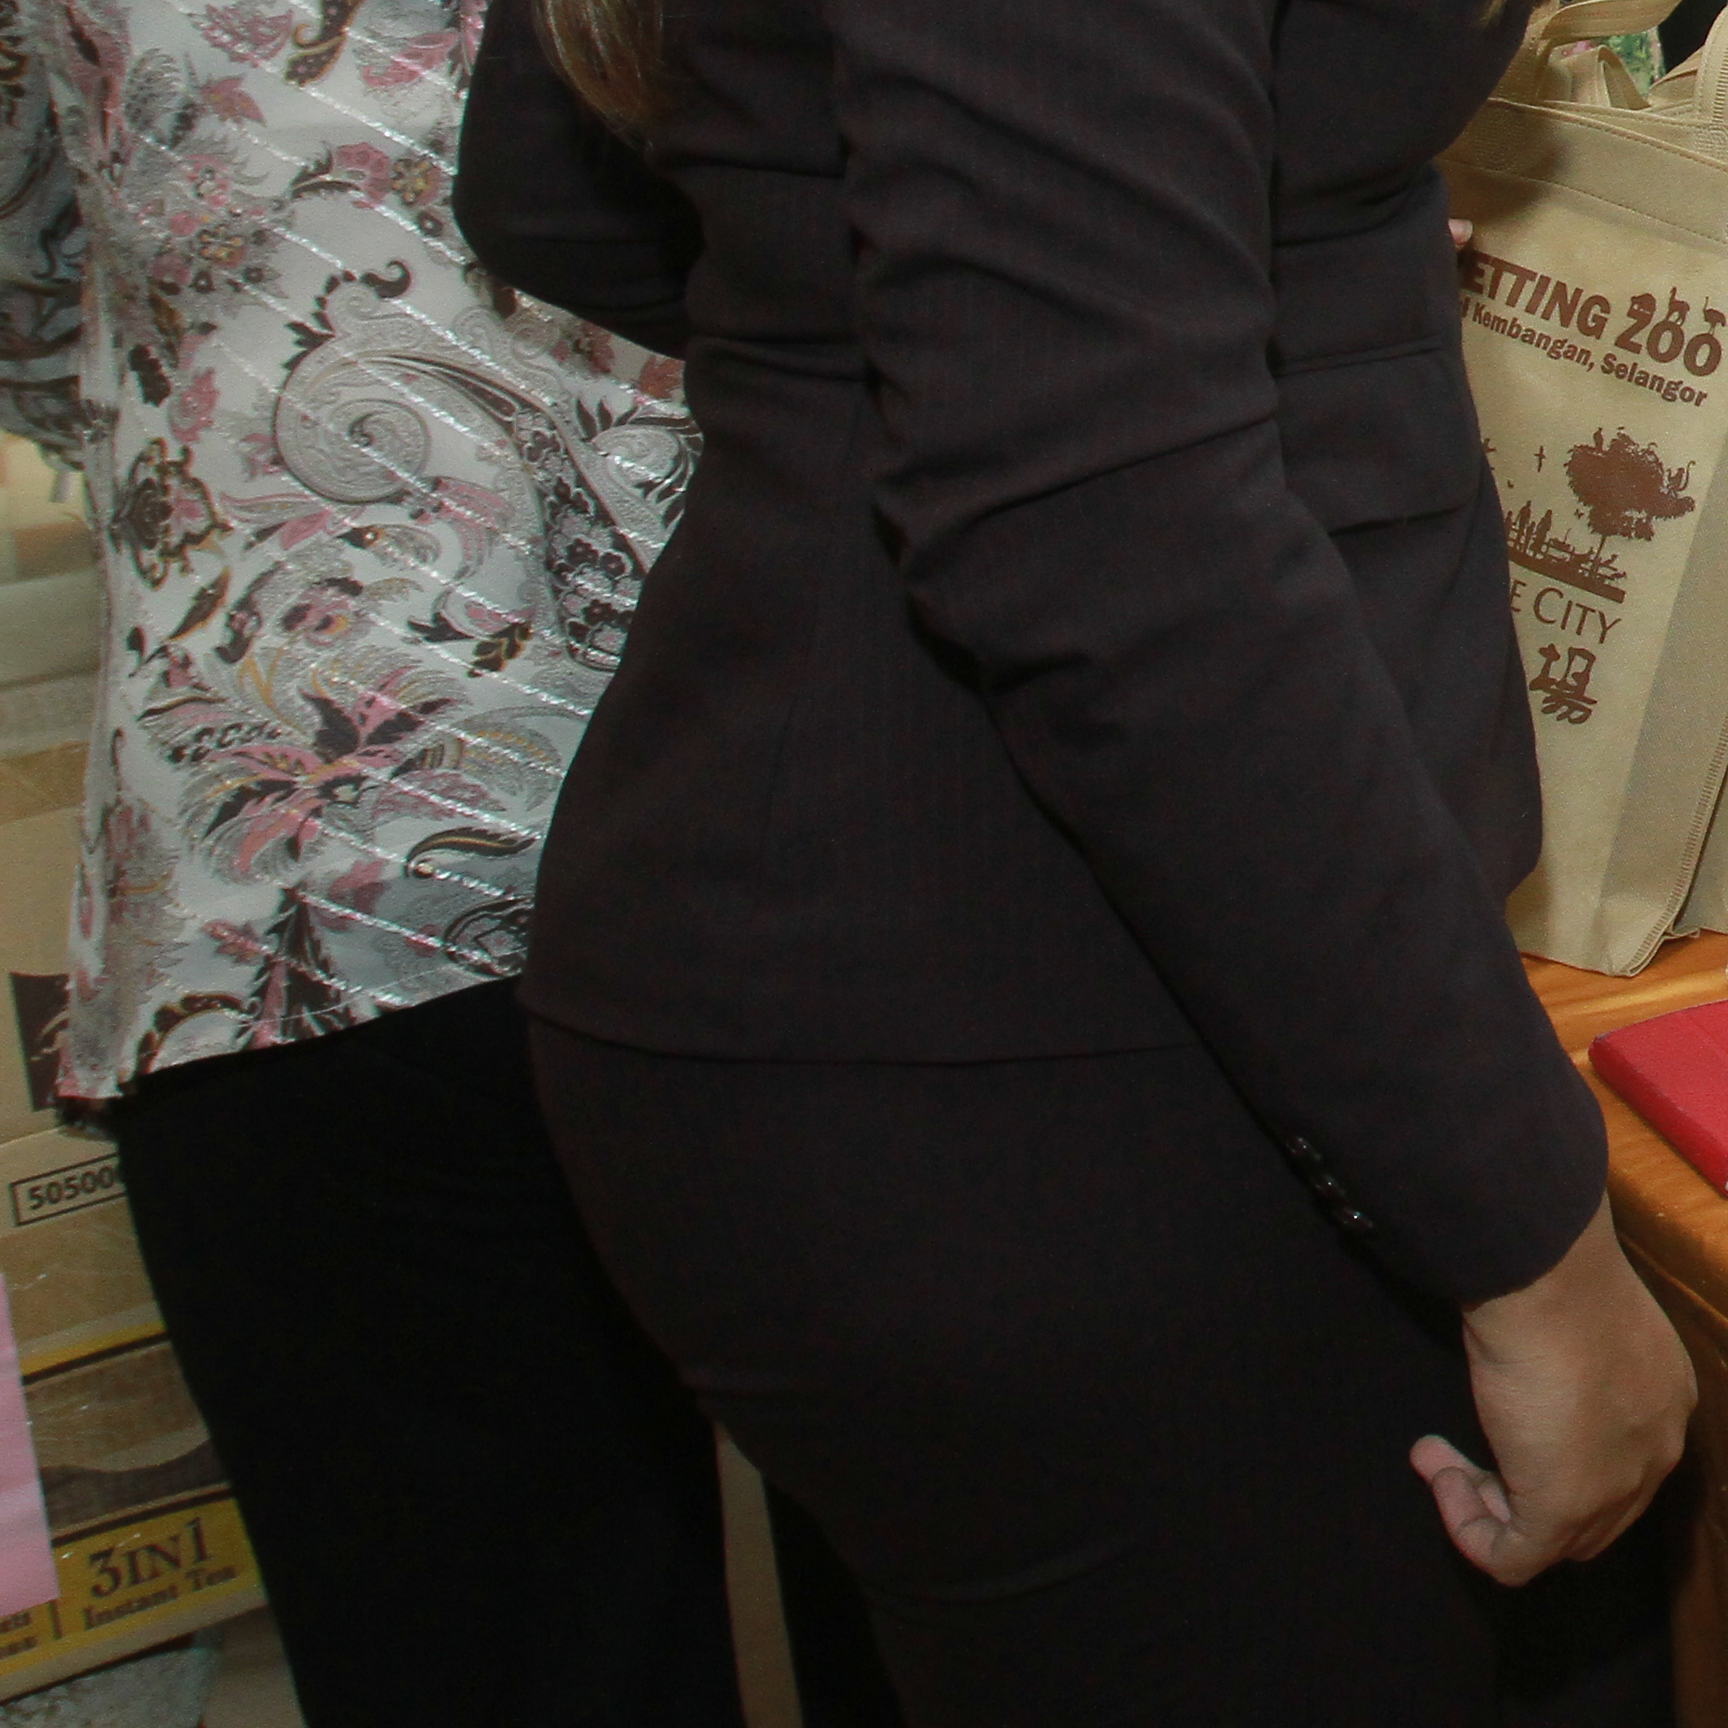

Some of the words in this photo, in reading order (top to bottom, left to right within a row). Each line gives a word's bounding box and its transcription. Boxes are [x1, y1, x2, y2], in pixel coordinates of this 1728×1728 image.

[1461, 248, 1611, 340] ETTING
[1473, 301, 1596, 372] Kembangan,
[1600, 353, 1708, 407] Selangor
[1533, 587, 1622, 644] CITY
[27, 1164, 120, 1210] 50500
